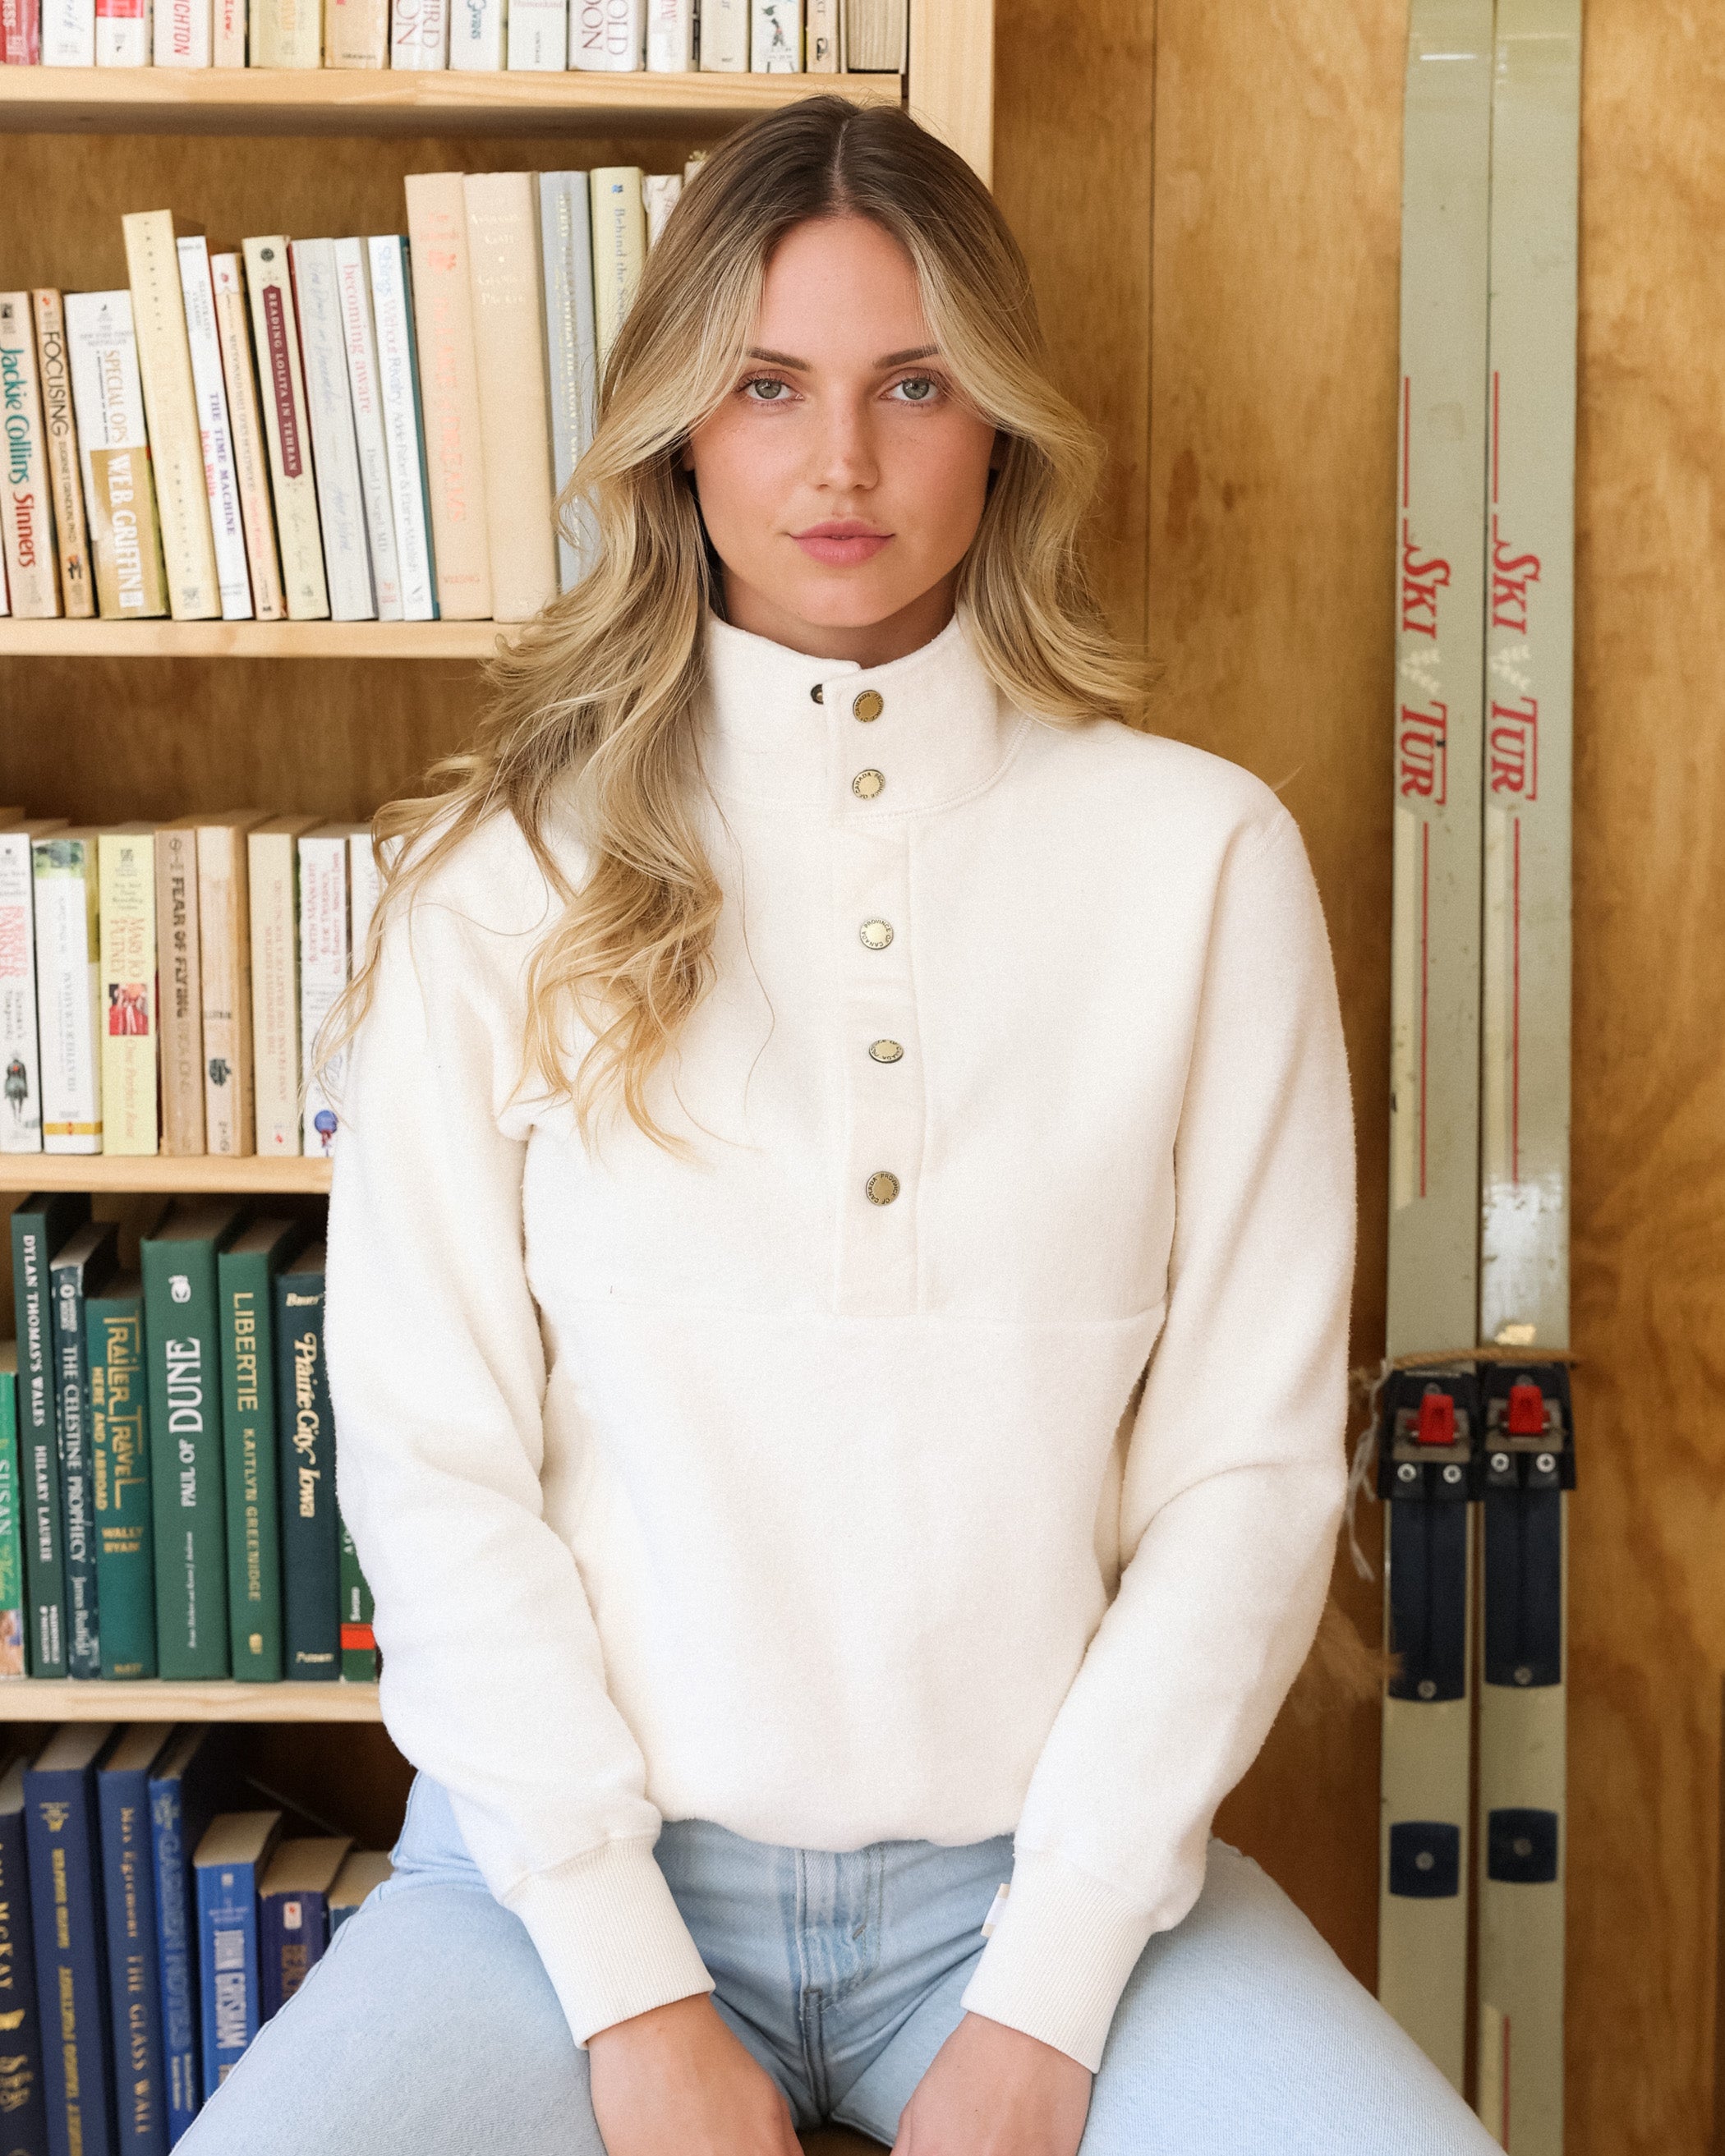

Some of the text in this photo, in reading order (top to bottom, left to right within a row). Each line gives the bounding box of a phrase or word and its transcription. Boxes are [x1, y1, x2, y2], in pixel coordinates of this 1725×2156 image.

[173, 0, 191, 55] CHTON
[582, 0, 604, 50] ON
[614, 209, 626, 257] Behind
[41, 332, 68, 437] FOCUSING
[268, 293, 297, 471] READING LOLITA IN TEHRAN
[342, 264, 374, 414] becoming aware
[0, 347, 32, 485] Jackie Collins
[104, 350, 127, 444] SPECIAL OPS
[209, 393, 236, 536] THE TIME MACHINE
[12, 493, 36, 567] Sinners
[111, 509, 142, 591] GRIFFIN
[1400, 700, 1447, 806] TUR
[1490, 696, 1539, 802] TUR
[172, 876, 189, 1019] FEAR OF FLYING
[862, 931, 884, 947] CANADA
[864, 919, 891, 932] PROVINCE
[21, 1234, 46, 1426] DYLAN THOMAS'S WALES
[62, 1345, 80, 1379] THE
[232, 1292, 258, 1412] LIBERTIE
[293, 1332, 319, 1409] Prairie
[64, 1384, 83, 1469] CELESTINE
[165, 1337, 202, 1433] DUNE
[91, 1366, 108, 1510] HERE AND ABROAD
[178, 1438, 196, 1507] PAUL OF
[34, 1446, 53, 1561] HILARY LAURIE
[67, 1475, 88, 1563] PROPHECY
[242, 1427, 261, 1601] KAITLYN GREENIDGE
[298, 1466, 320, 1517] Iowa
[159, 1832, 185, 1949] GARDEN
[127, 1954, 150, 2134] THE GLASS WALL
